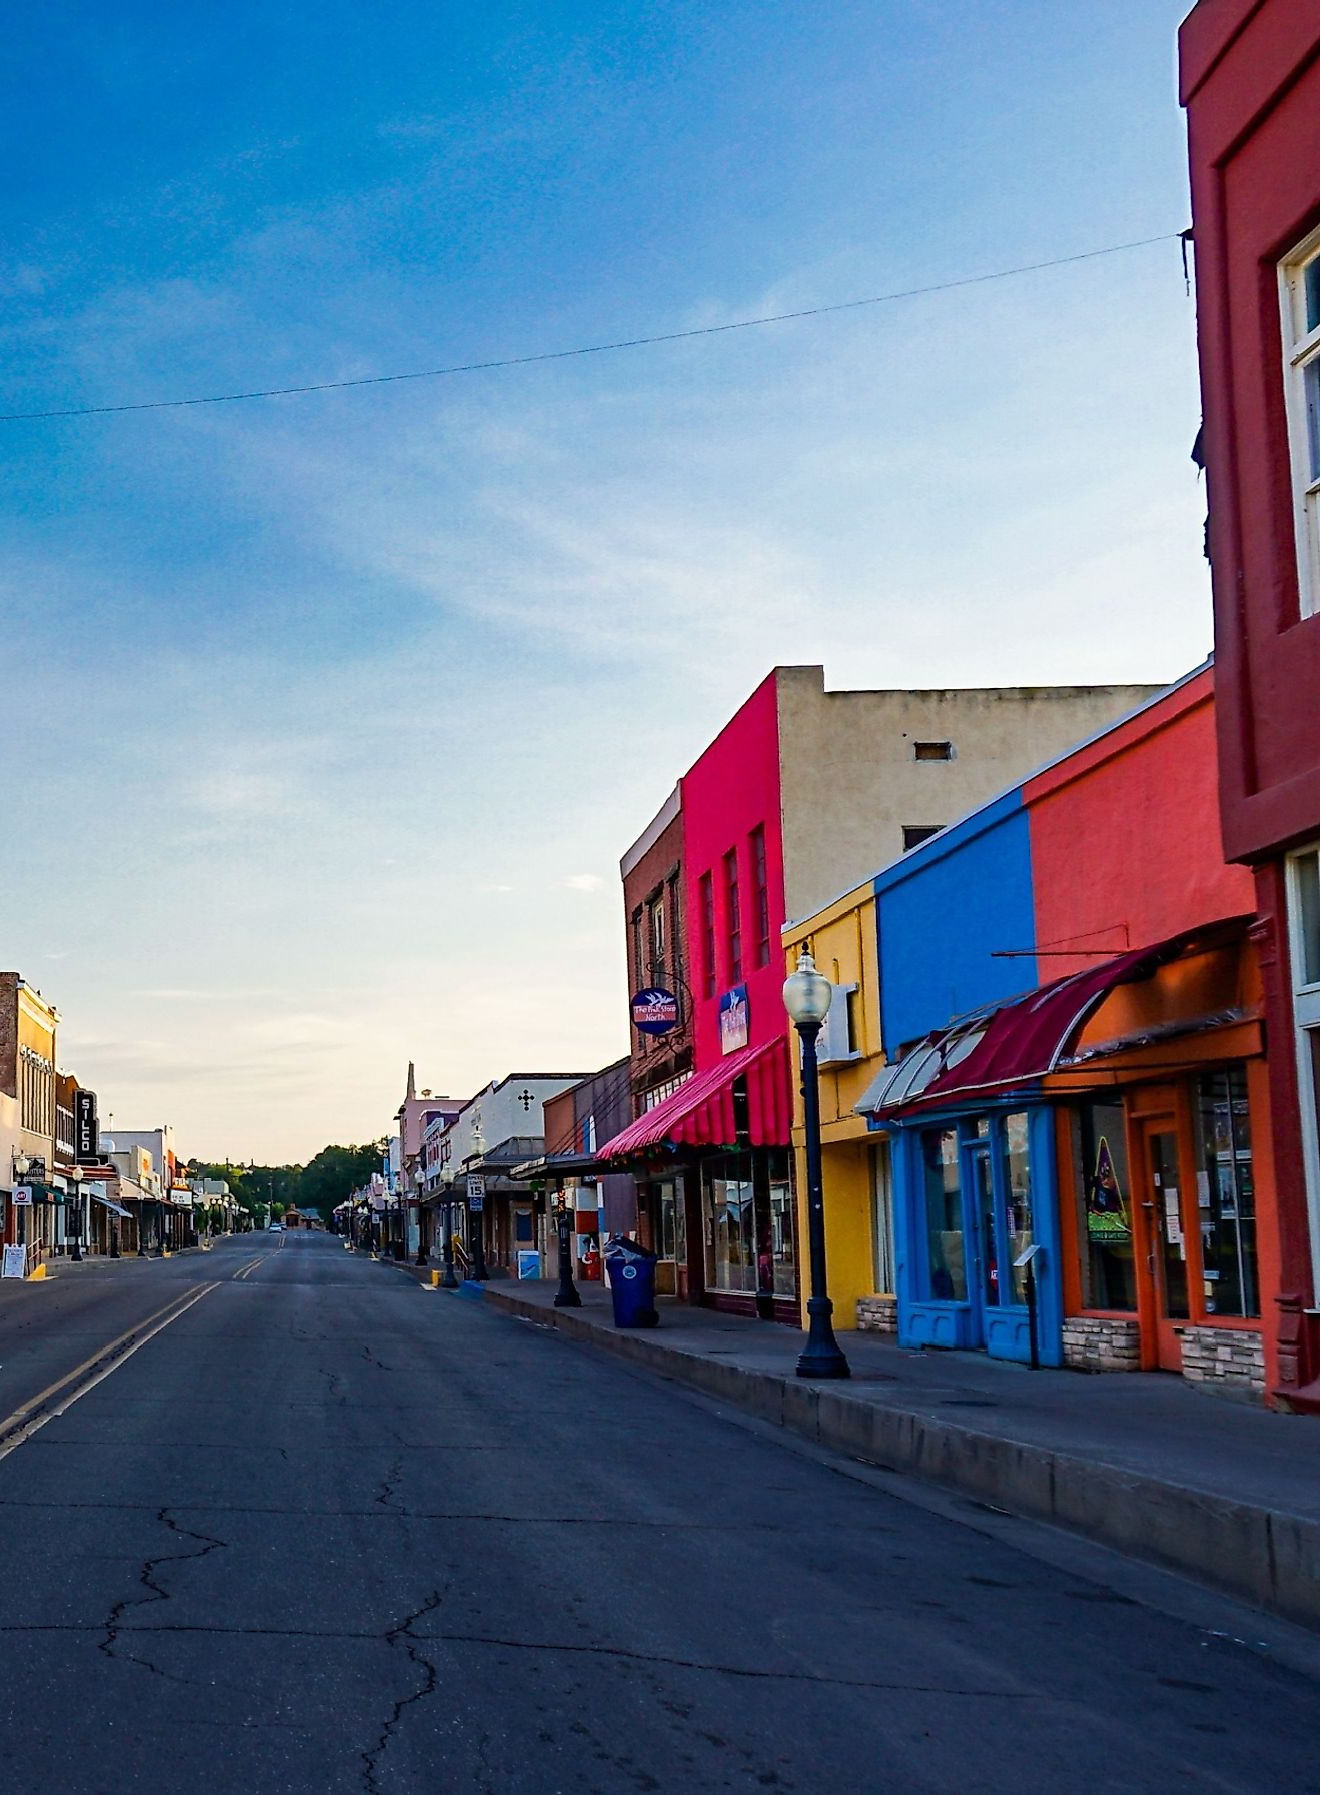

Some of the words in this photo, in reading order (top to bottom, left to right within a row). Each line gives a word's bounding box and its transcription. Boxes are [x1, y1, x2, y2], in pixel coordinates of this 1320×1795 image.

[645, 1013, 666, 1022] North
[81, 1099, 90, 1152] SILCO
[470, 1186, 482, 1196] 15
